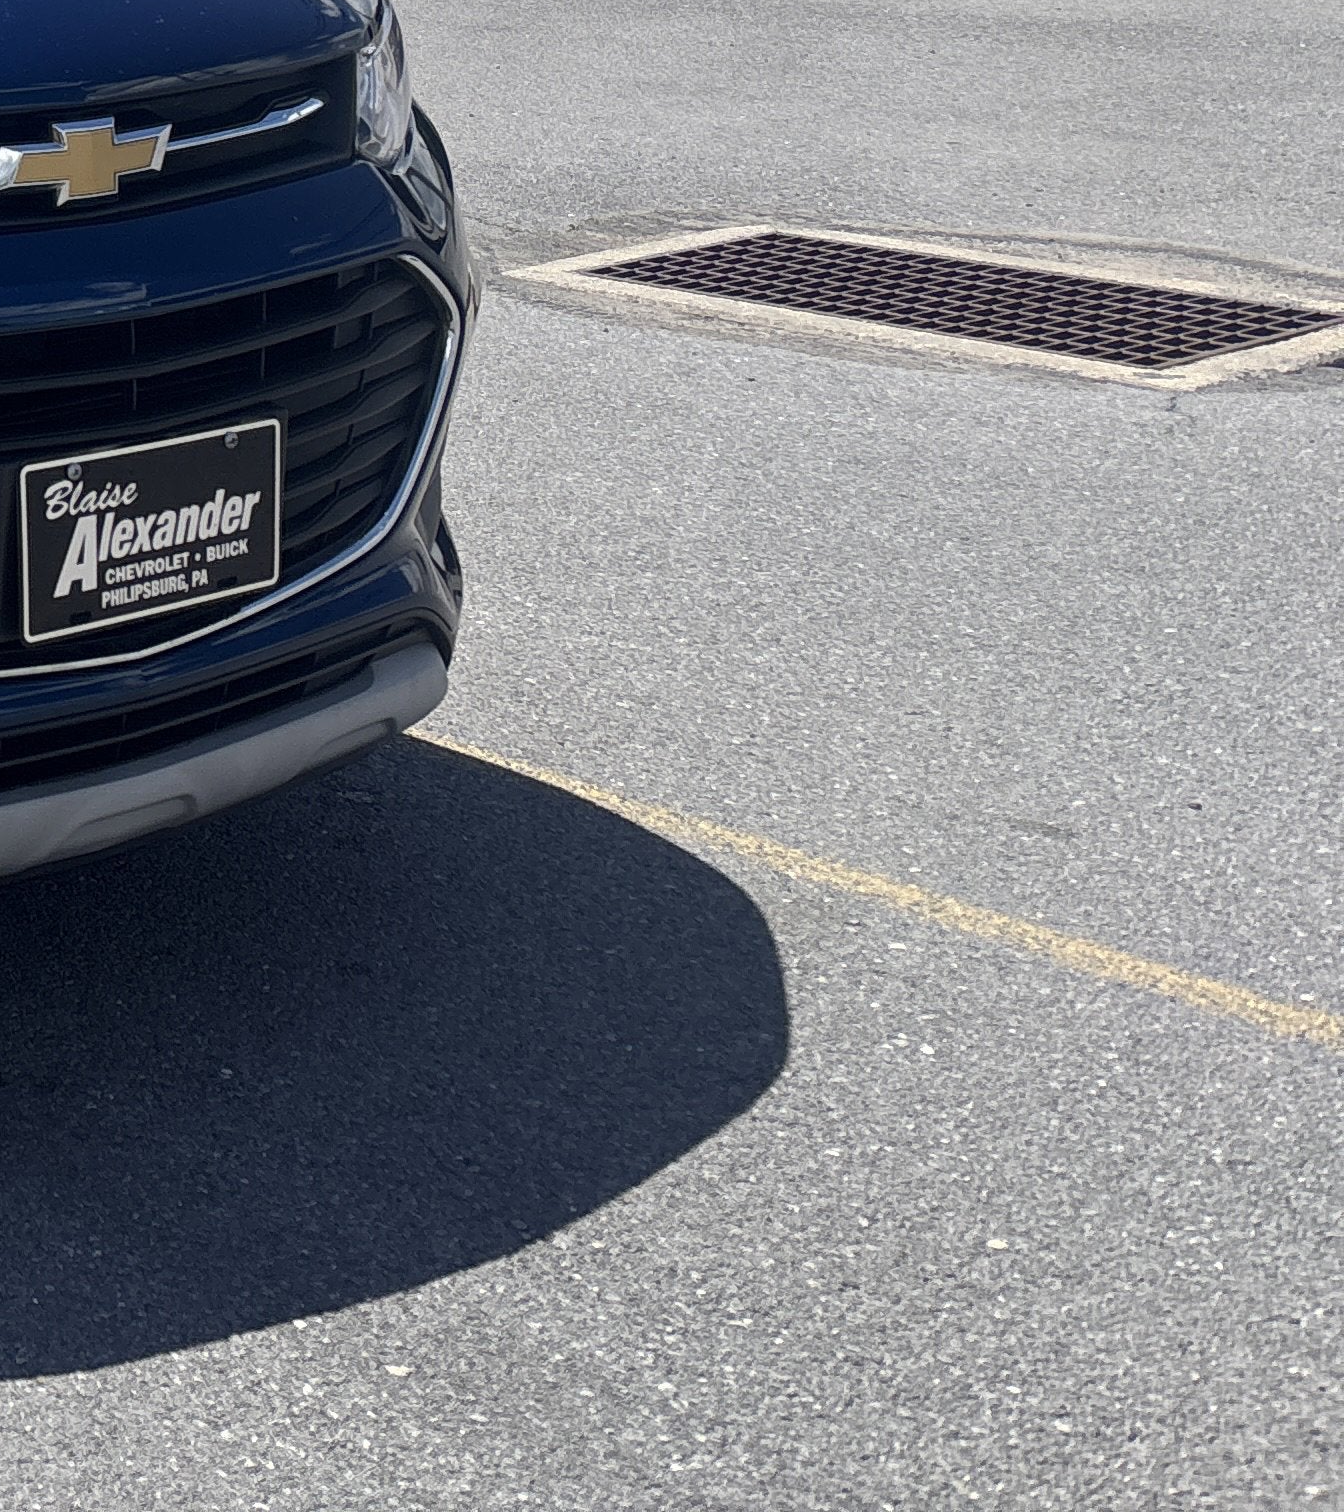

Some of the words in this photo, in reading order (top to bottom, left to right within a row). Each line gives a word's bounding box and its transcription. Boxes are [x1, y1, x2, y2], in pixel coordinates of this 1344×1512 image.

[44, 480, 138, 520] Blaise
[53, 488, 261, 599] Alexander
[105, 551, 190, 585] CHEVROLET
[206, 538, 249, 562] BUICK
[101, 573, 189, 609] PHILIPSBURG,
[192, 569, 209, 587] PA
